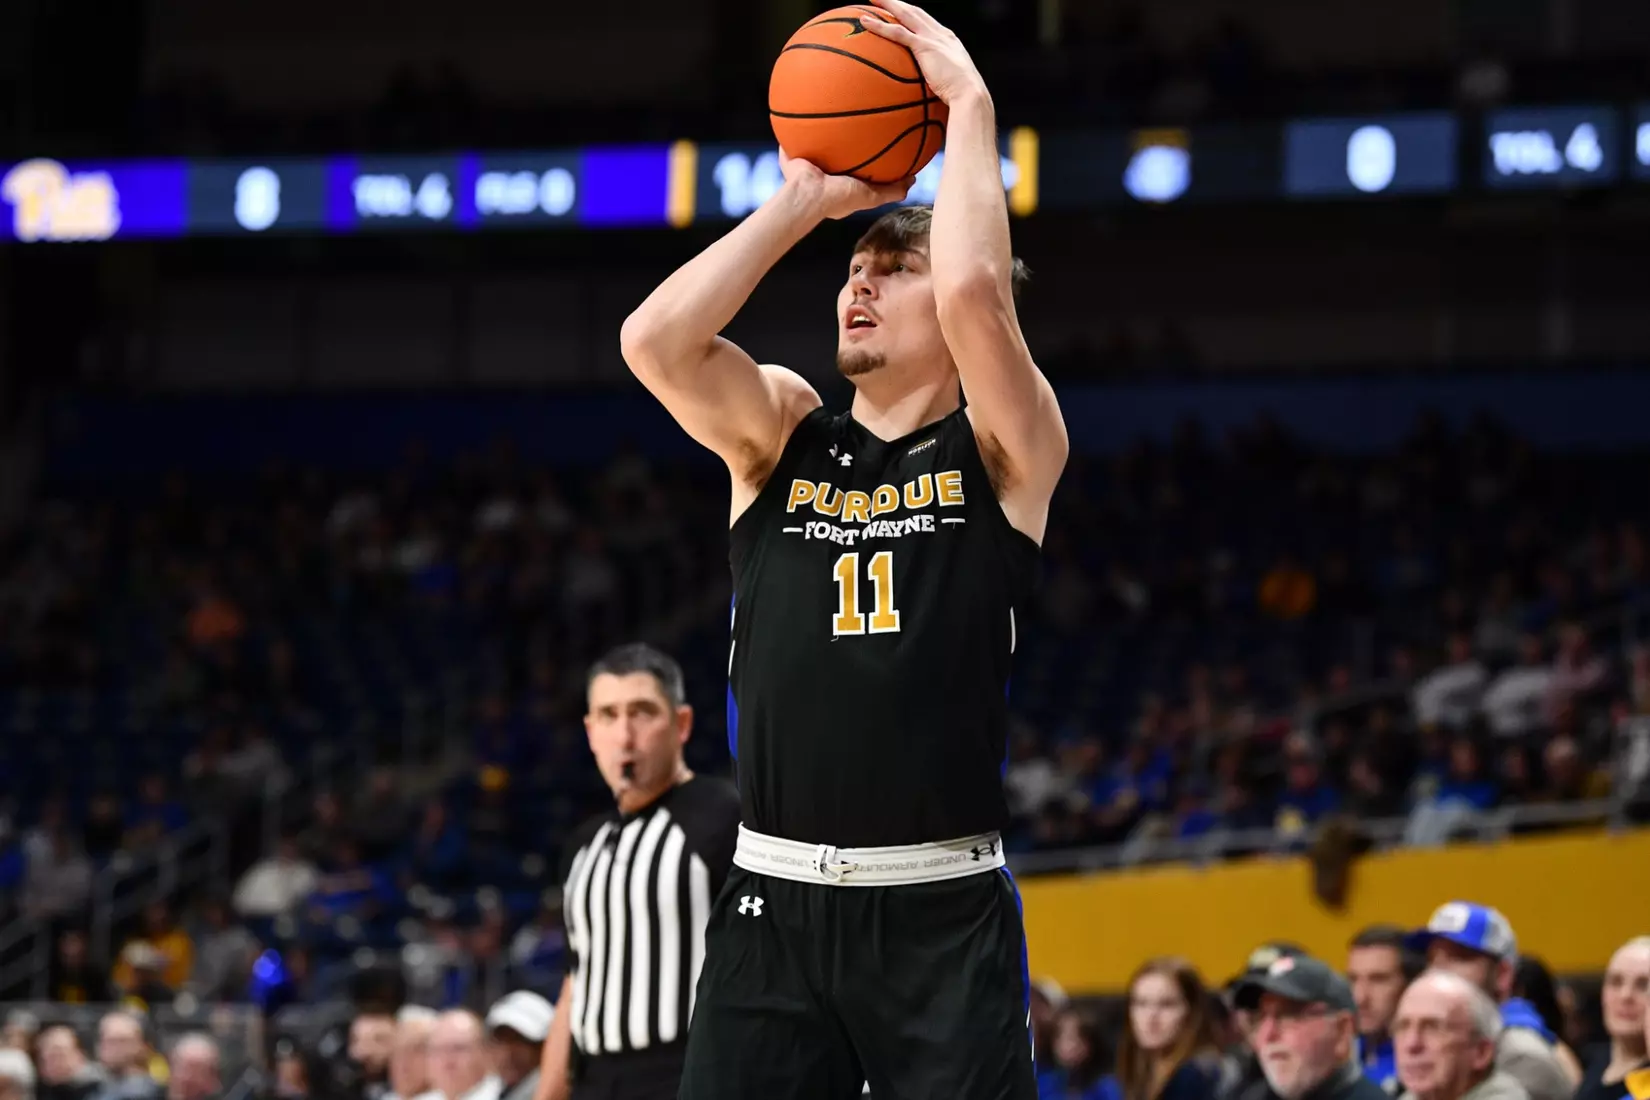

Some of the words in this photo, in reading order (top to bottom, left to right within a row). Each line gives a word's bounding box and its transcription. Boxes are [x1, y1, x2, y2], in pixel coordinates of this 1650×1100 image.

[786, 470, 965, 524] PURDUE
[805, 521, 859, 545] FORT
[862, 514, 936, 541] WAYNE
[833, 551, 900, 636] 11
[924, 853, 966, 868] UNDER
